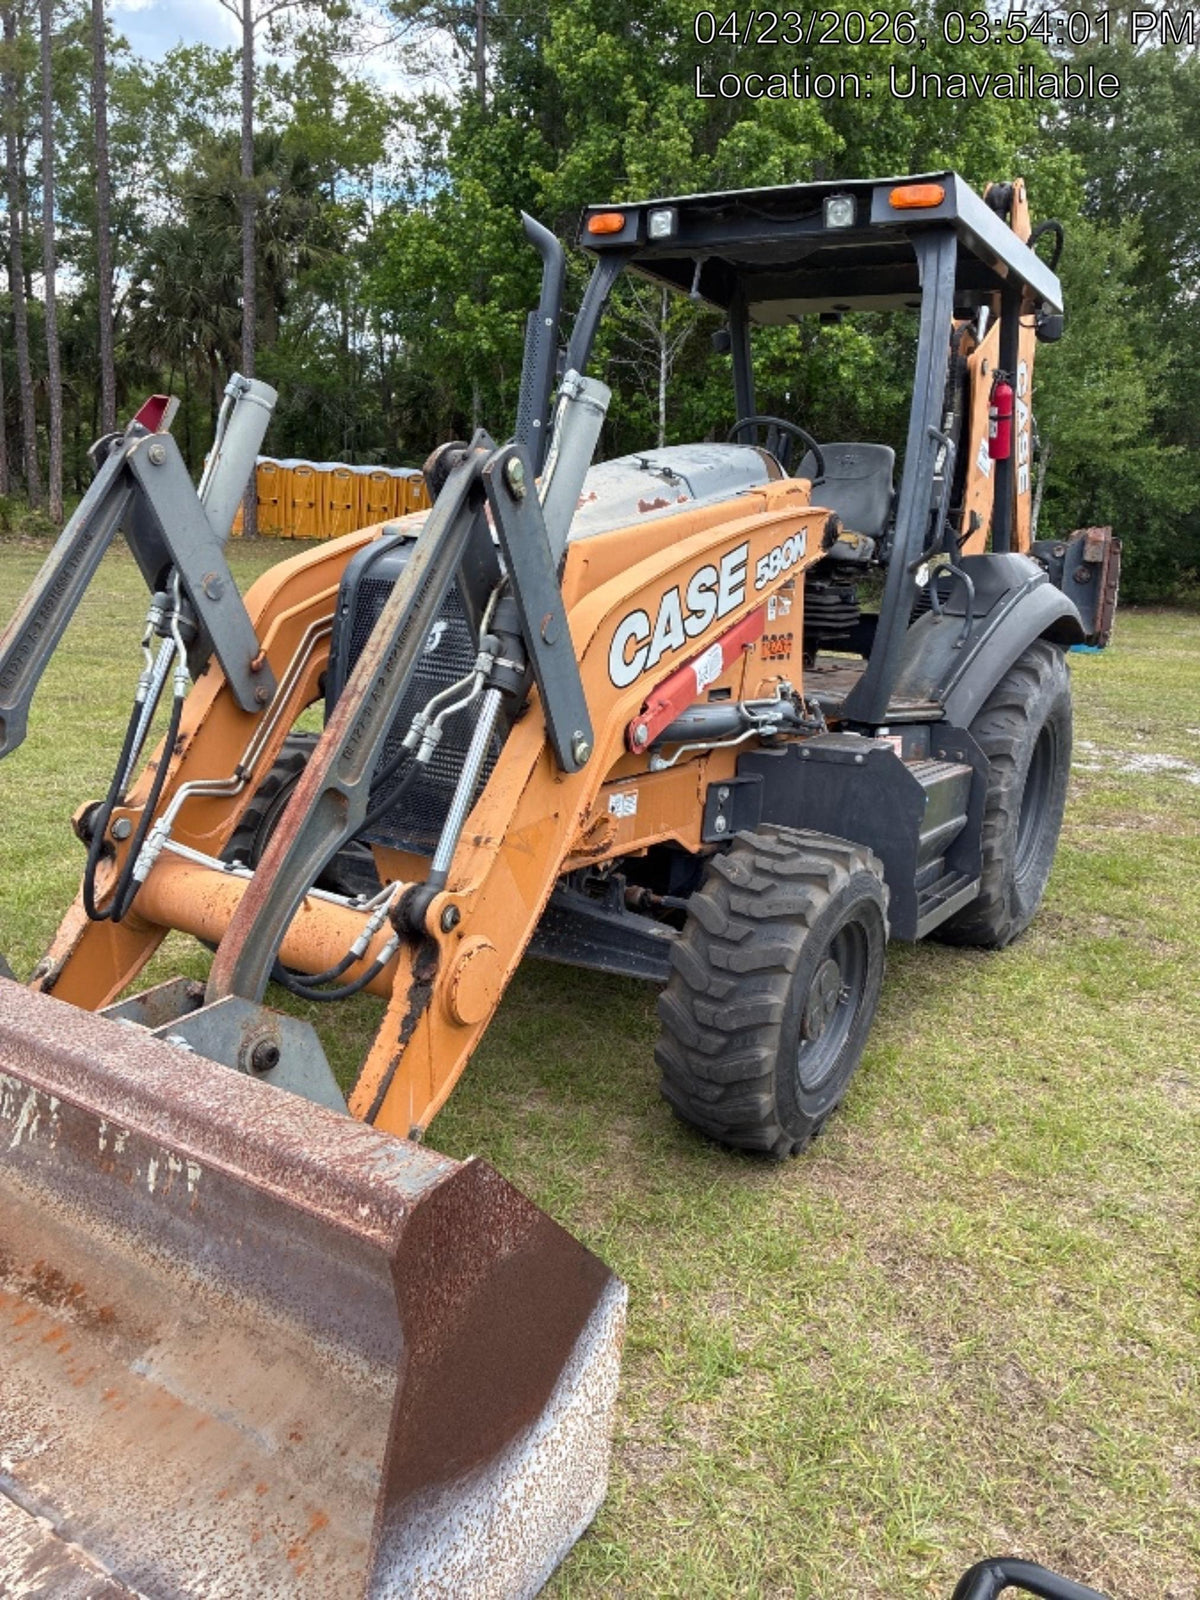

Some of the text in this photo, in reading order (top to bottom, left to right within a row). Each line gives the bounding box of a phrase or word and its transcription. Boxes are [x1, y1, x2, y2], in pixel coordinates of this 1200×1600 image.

[1015, 359, 1028, 495] CASE
[608, 526, 807, 688] CASE 580N
